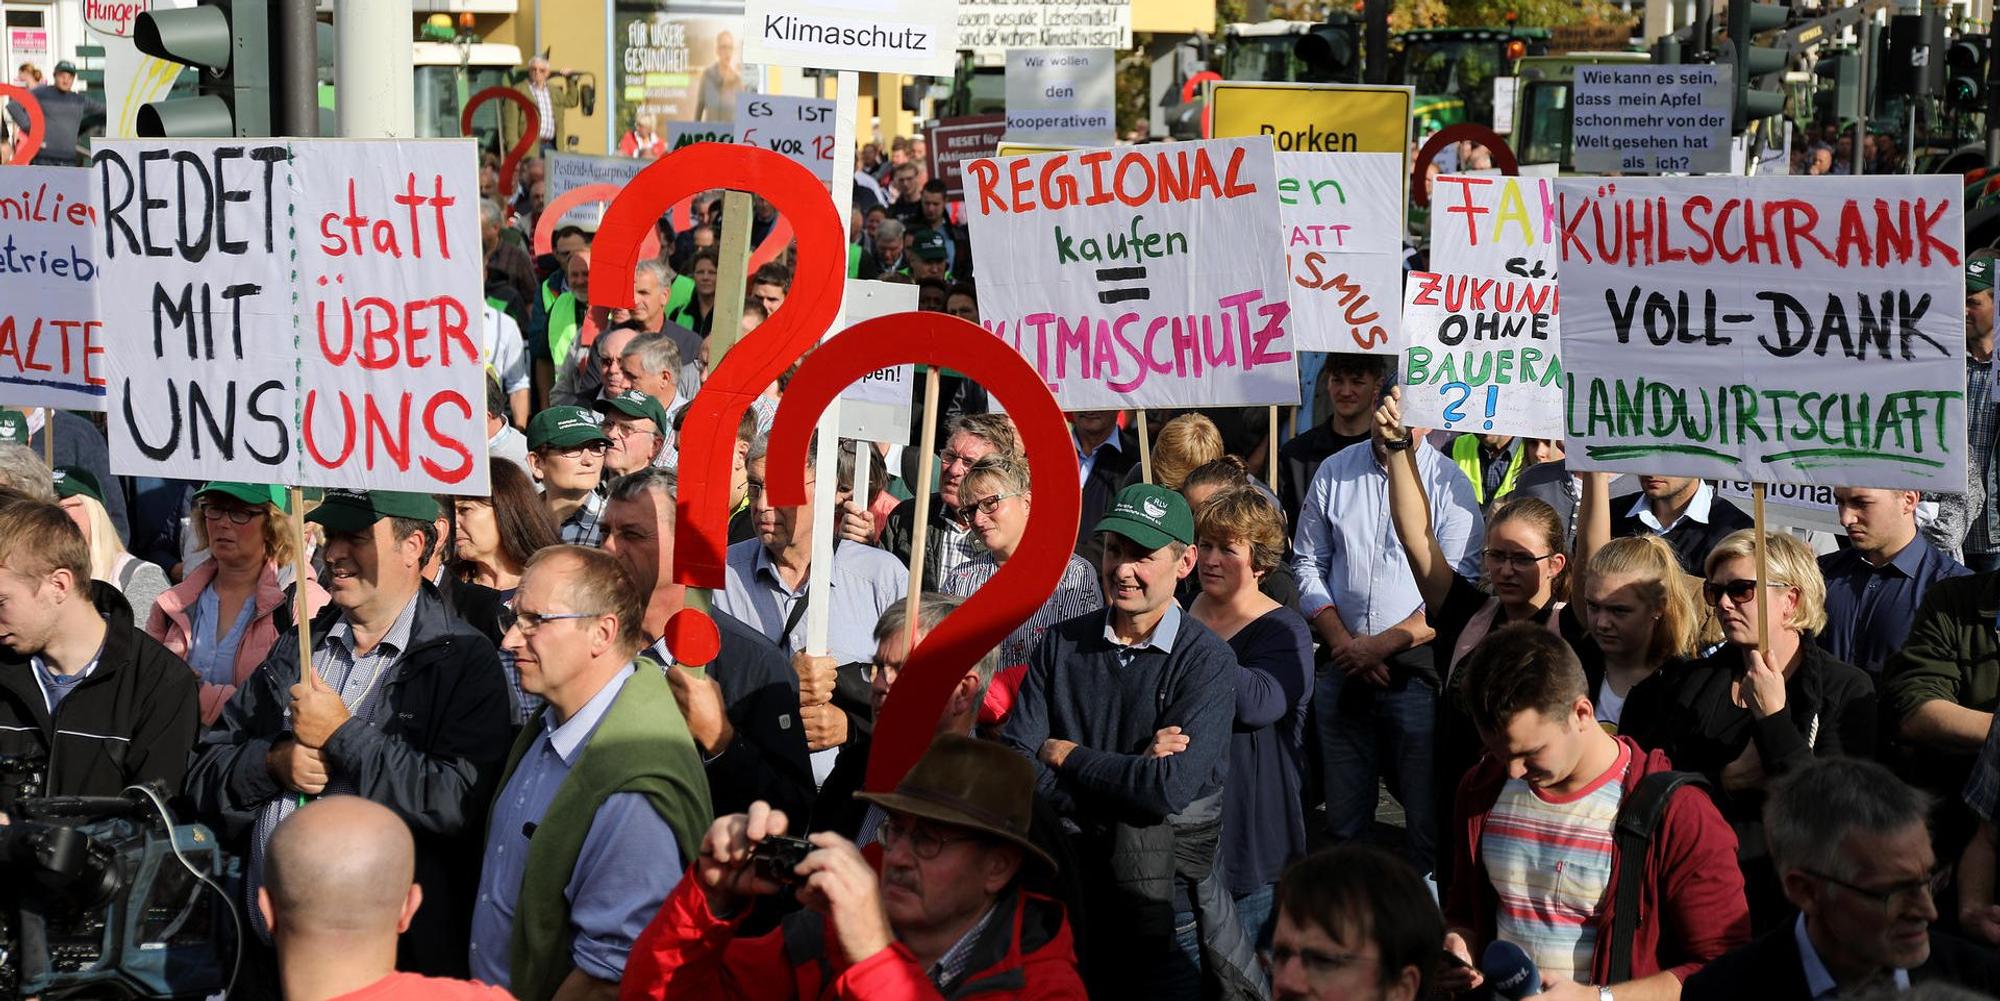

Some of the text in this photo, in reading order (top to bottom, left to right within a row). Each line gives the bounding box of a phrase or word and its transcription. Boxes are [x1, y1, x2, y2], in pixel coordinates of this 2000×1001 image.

[628, 19, 686, 47] FÜR UNSERE
[765, 14, 927, 50] Klimaschutz
[625, 47, 689, 73] GESUNDHEIT
[1025, 56, 1089, 67] Wir wollen
[1046, 86, 1073, 98] den
[1584, 71, 1717, 86] Wie kann es sein,
[749, 101, 833, 123] ES IST
[1575, 93, 1701, 108] dass mein Apfel
[1007, 115, 1106, 130] kooperativen
[1575, 114, 1725, 127] schon mehr von der
[743, 128, 835, 160] 5 VOR 12
[948, 135, 980, 148] RESET
[1576, 135, 1708, 150] Welt gesehen hat
[1623, 156, 1689, 169] als ich?
[967, 146, 1257, 216] REGIONAL
[1279, 177, 1345, 204] en
[93, 146, 295, 262] REDET
[320, 172, 456, 259] statt
[1054, 215, 1188, 265] kaufen
[1284, 225, 1351, 247] ATT
[1559, 183, 1960, 269] KÜHLSCHRANK
[0, 234, 99, 281] trieb
[153, 281, 262, 360] MIT
[315, 273, 480, 370] ÜBER
[1438, 312, 1549, 346] OHNE
[1605, 286, 1951, 361] VOLL-DANK
[0, 315, 106, 385] ALTE
[123, 377, 289, 465] UNS
[1565, 371, 1964, 454] LANDWIRTSCHAFT
[303, 389, 474, 484] UNS
